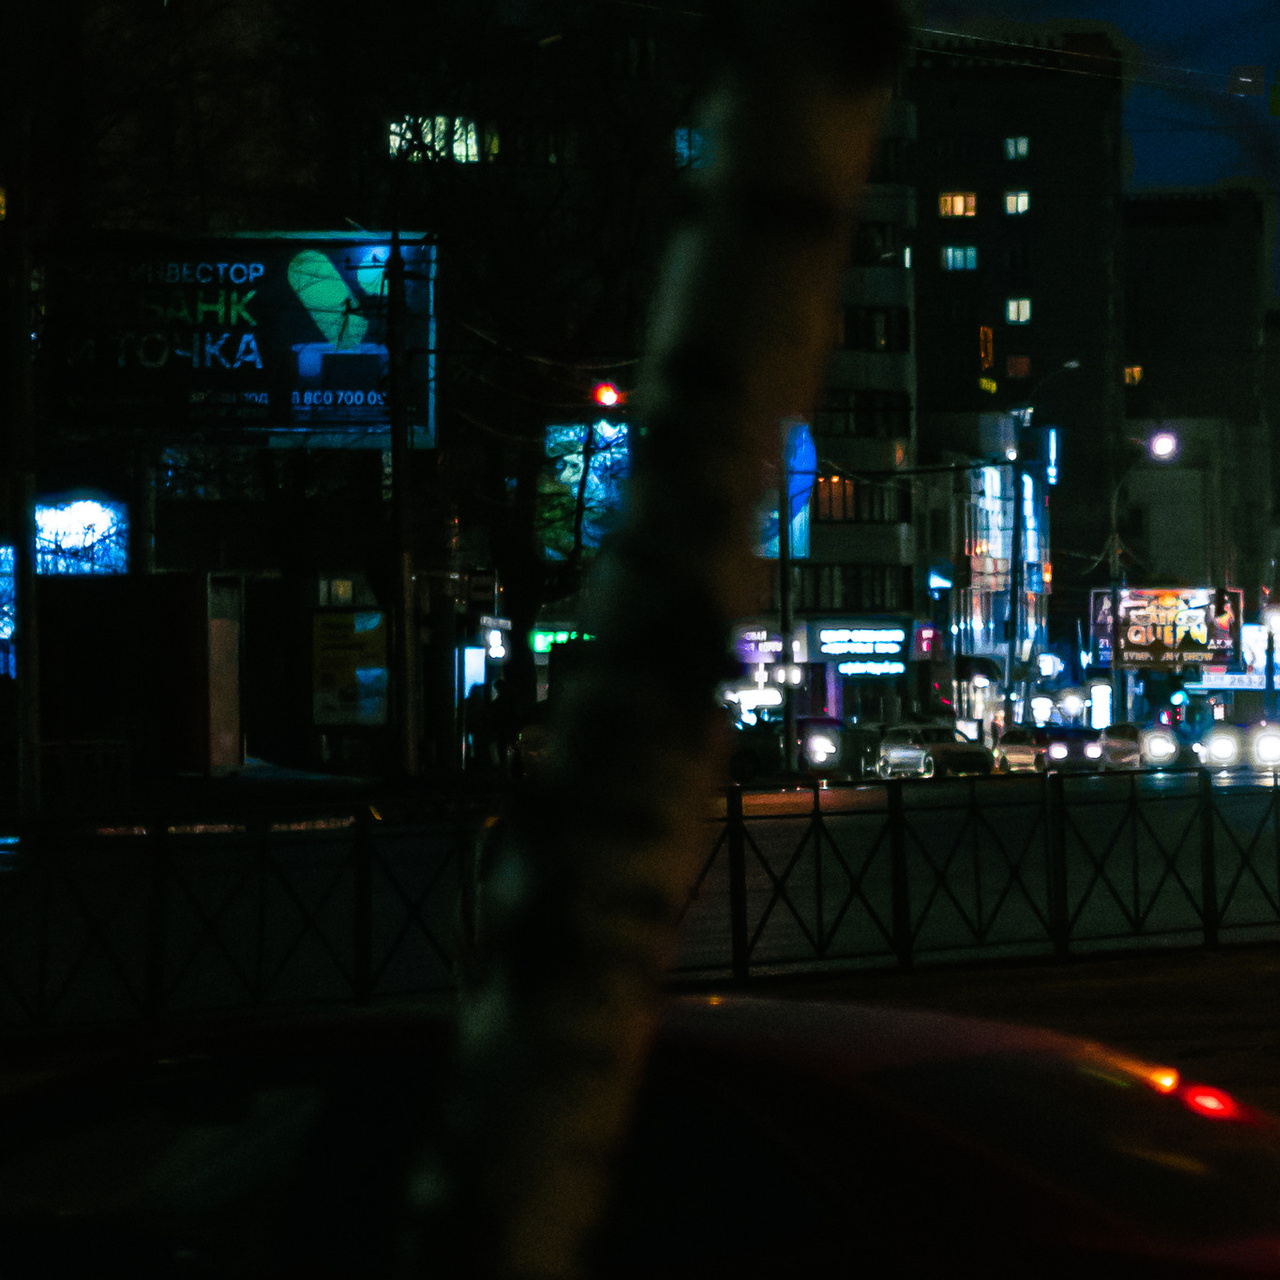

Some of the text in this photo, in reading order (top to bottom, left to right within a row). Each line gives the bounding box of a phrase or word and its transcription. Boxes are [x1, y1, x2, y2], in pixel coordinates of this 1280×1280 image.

[139, 289, 258, 326] БАНК
[111, 332, 264, 369] ТОЧКА
[336, 390, 364, 405] 700
